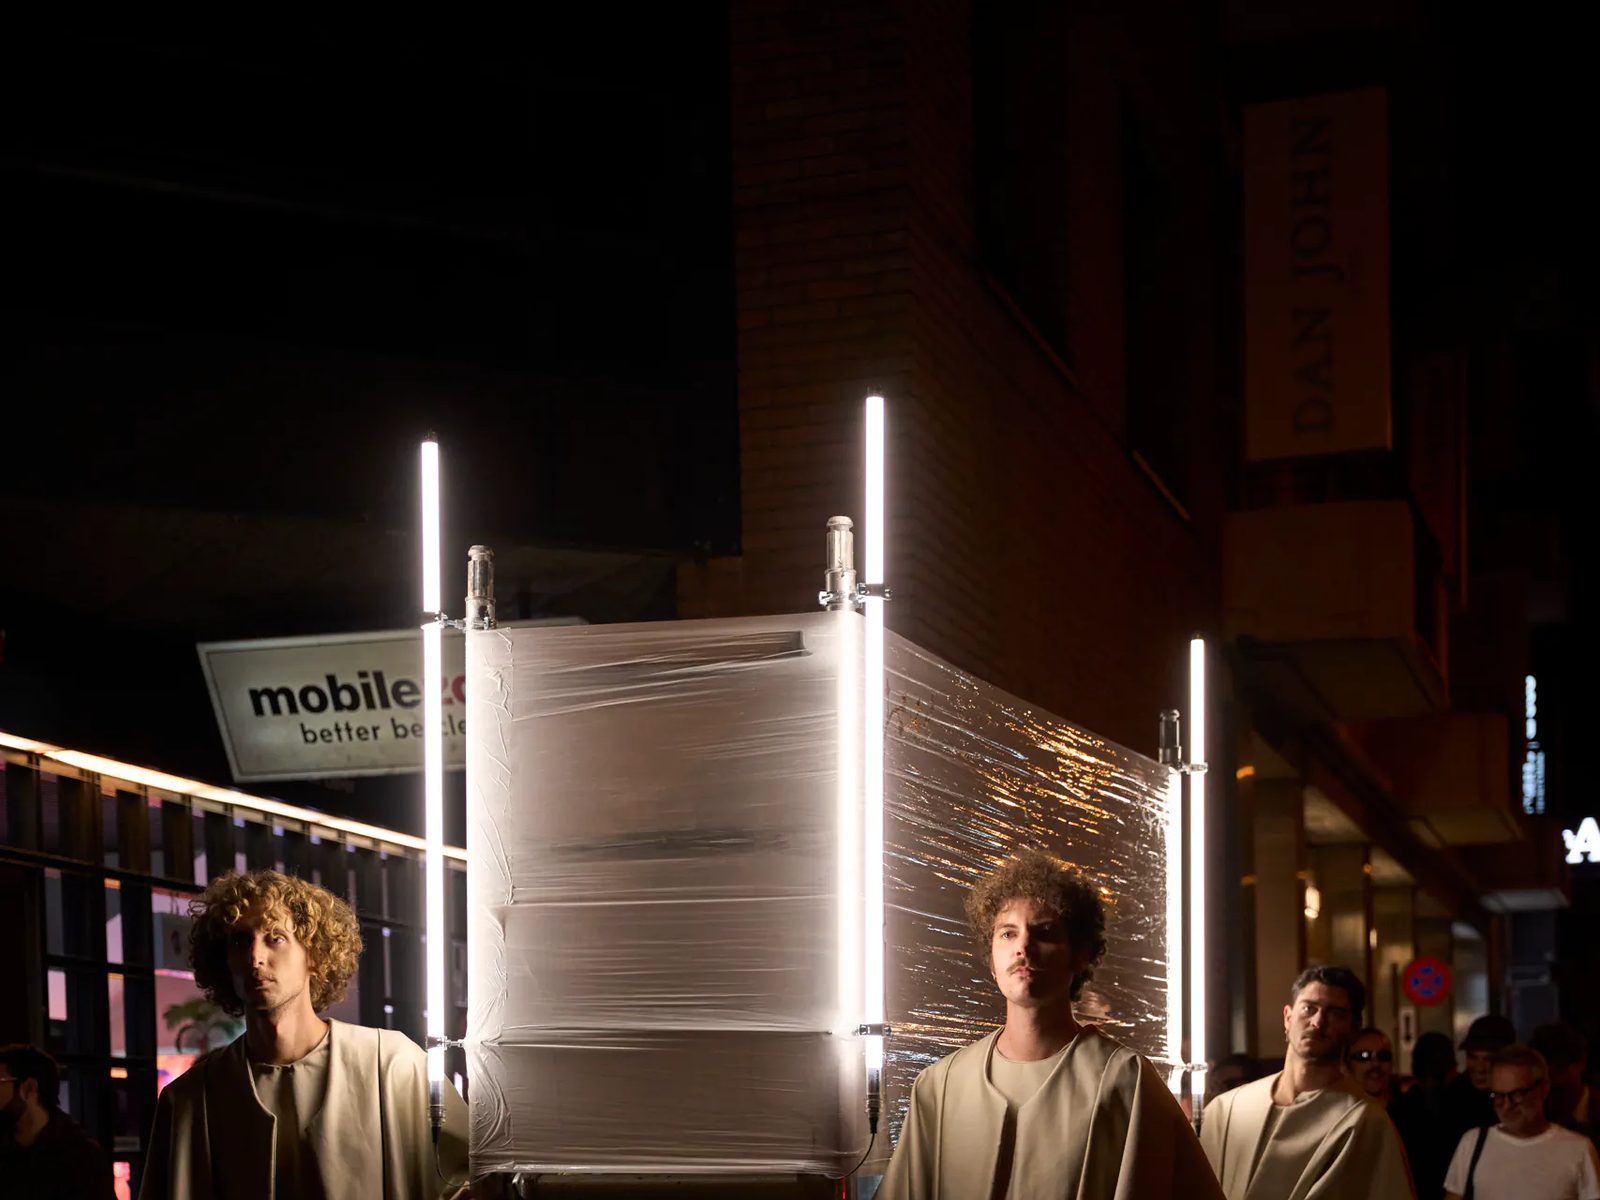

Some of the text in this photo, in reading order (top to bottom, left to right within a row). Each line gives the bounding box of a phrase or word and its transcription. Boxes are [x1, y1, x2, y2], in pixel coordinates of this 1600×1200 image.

[1291, 116, 1344, 433] DAN JOHN
[300, 723, 380, 744] better
